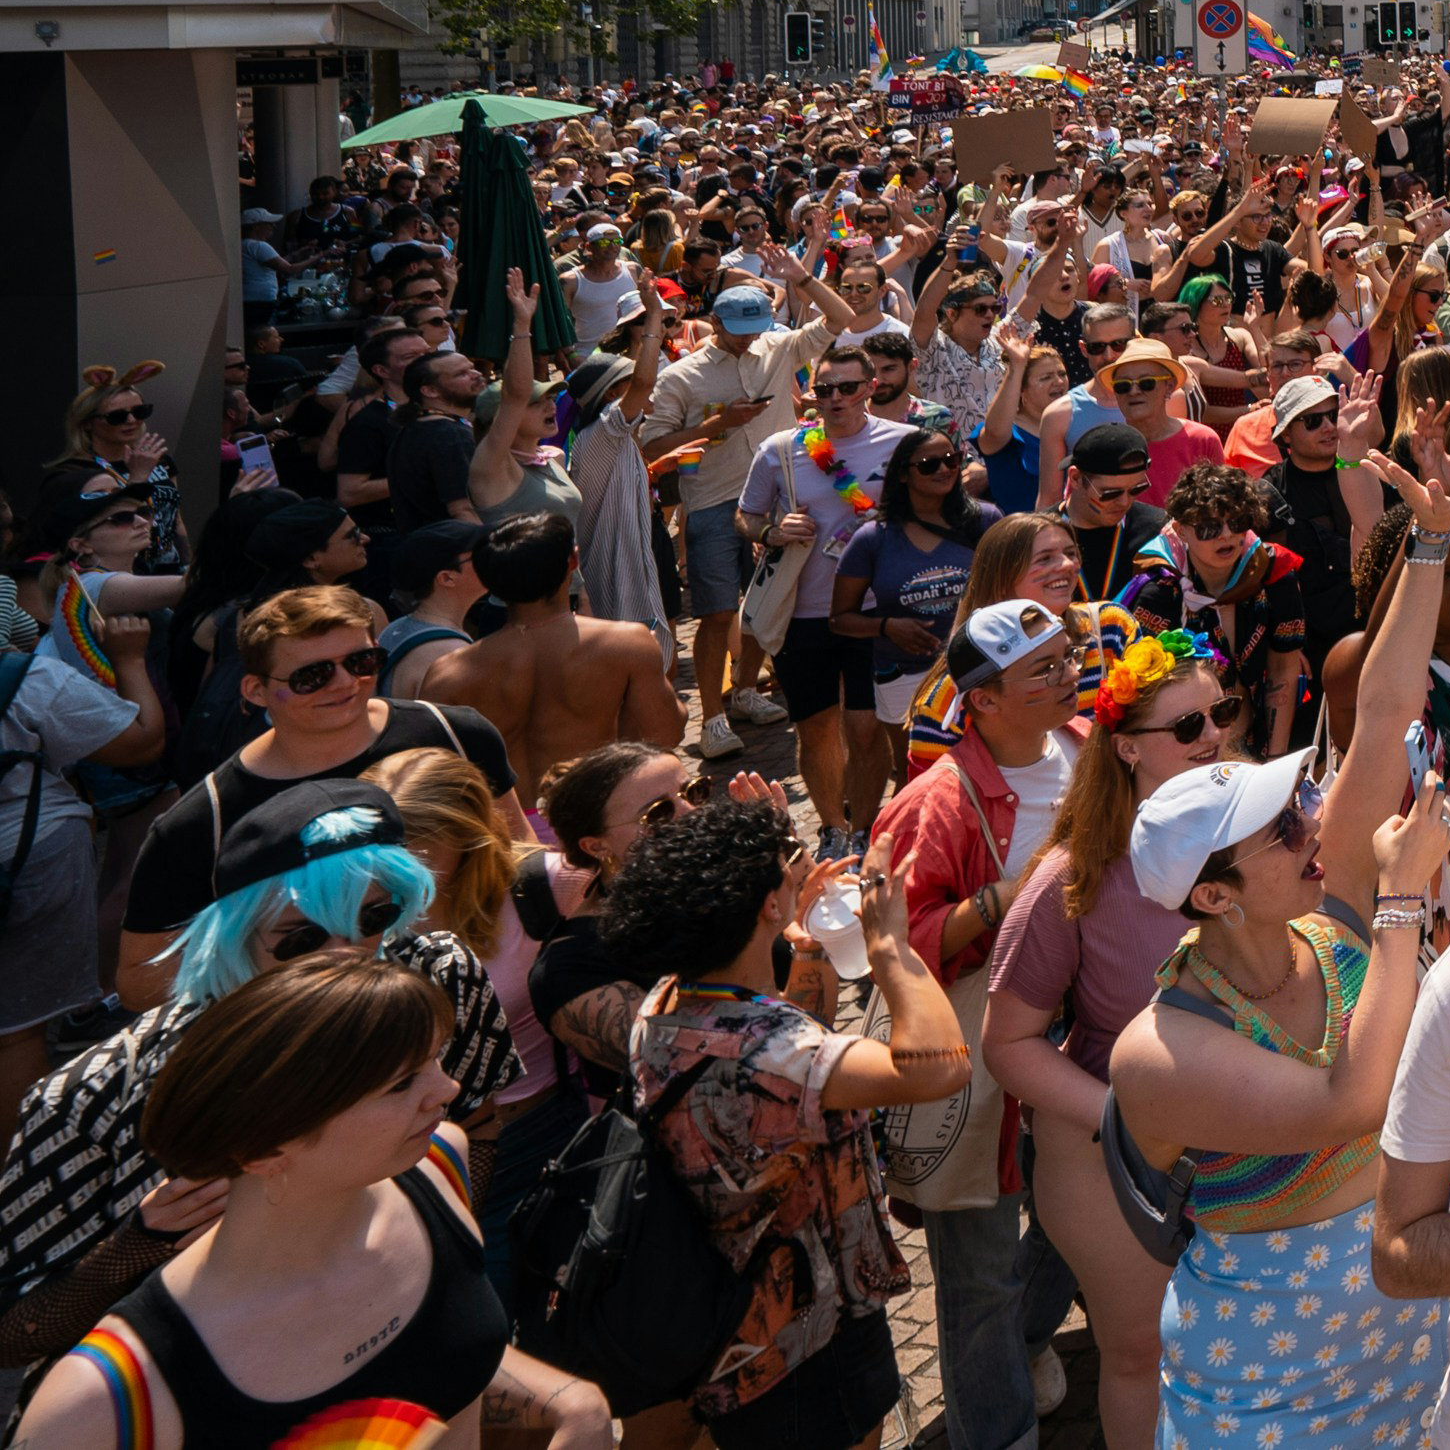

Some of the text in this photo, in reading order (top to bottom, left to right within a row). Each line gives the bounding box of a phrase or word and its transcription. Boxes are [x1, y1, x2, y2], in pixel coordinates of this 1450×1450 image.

[900, 587, 940, 606] CEDAR
[453, 1030, 481, 1081] BILLIE
[472, 1036, 498, 1090] EILISH
[1, 1175, 53, 1227] EILISH
[13, 1203, 68, 1253] BILLIE
[44, 1211, 106, 1264] BILLIE
